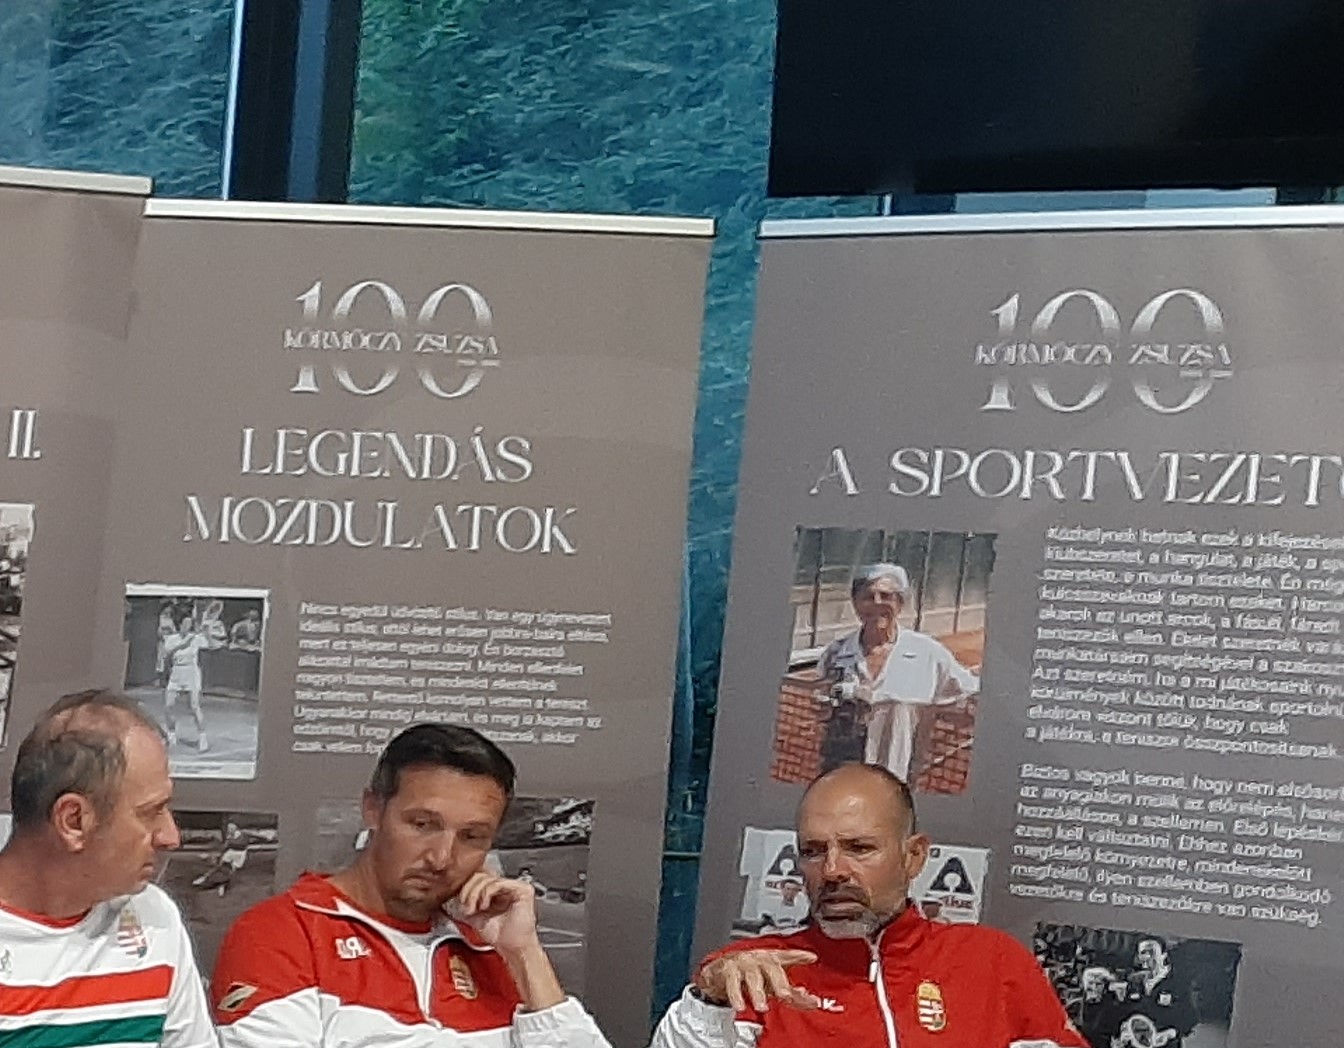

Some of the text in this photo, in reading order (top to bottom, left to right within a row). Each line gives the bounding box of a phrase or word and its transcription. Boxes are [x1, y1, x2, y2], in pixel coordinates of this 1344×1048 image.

[290, 281, 494, 399] 100
[979, 288, 1224, 414] 100
[8, 409, 42, 459] II.
[241, 426, 533, 483] LEGENDÁS
[810, 447, 1344, 507] A SPORTVEZET
[183, 495, 578, 555] MOZDULATOK
